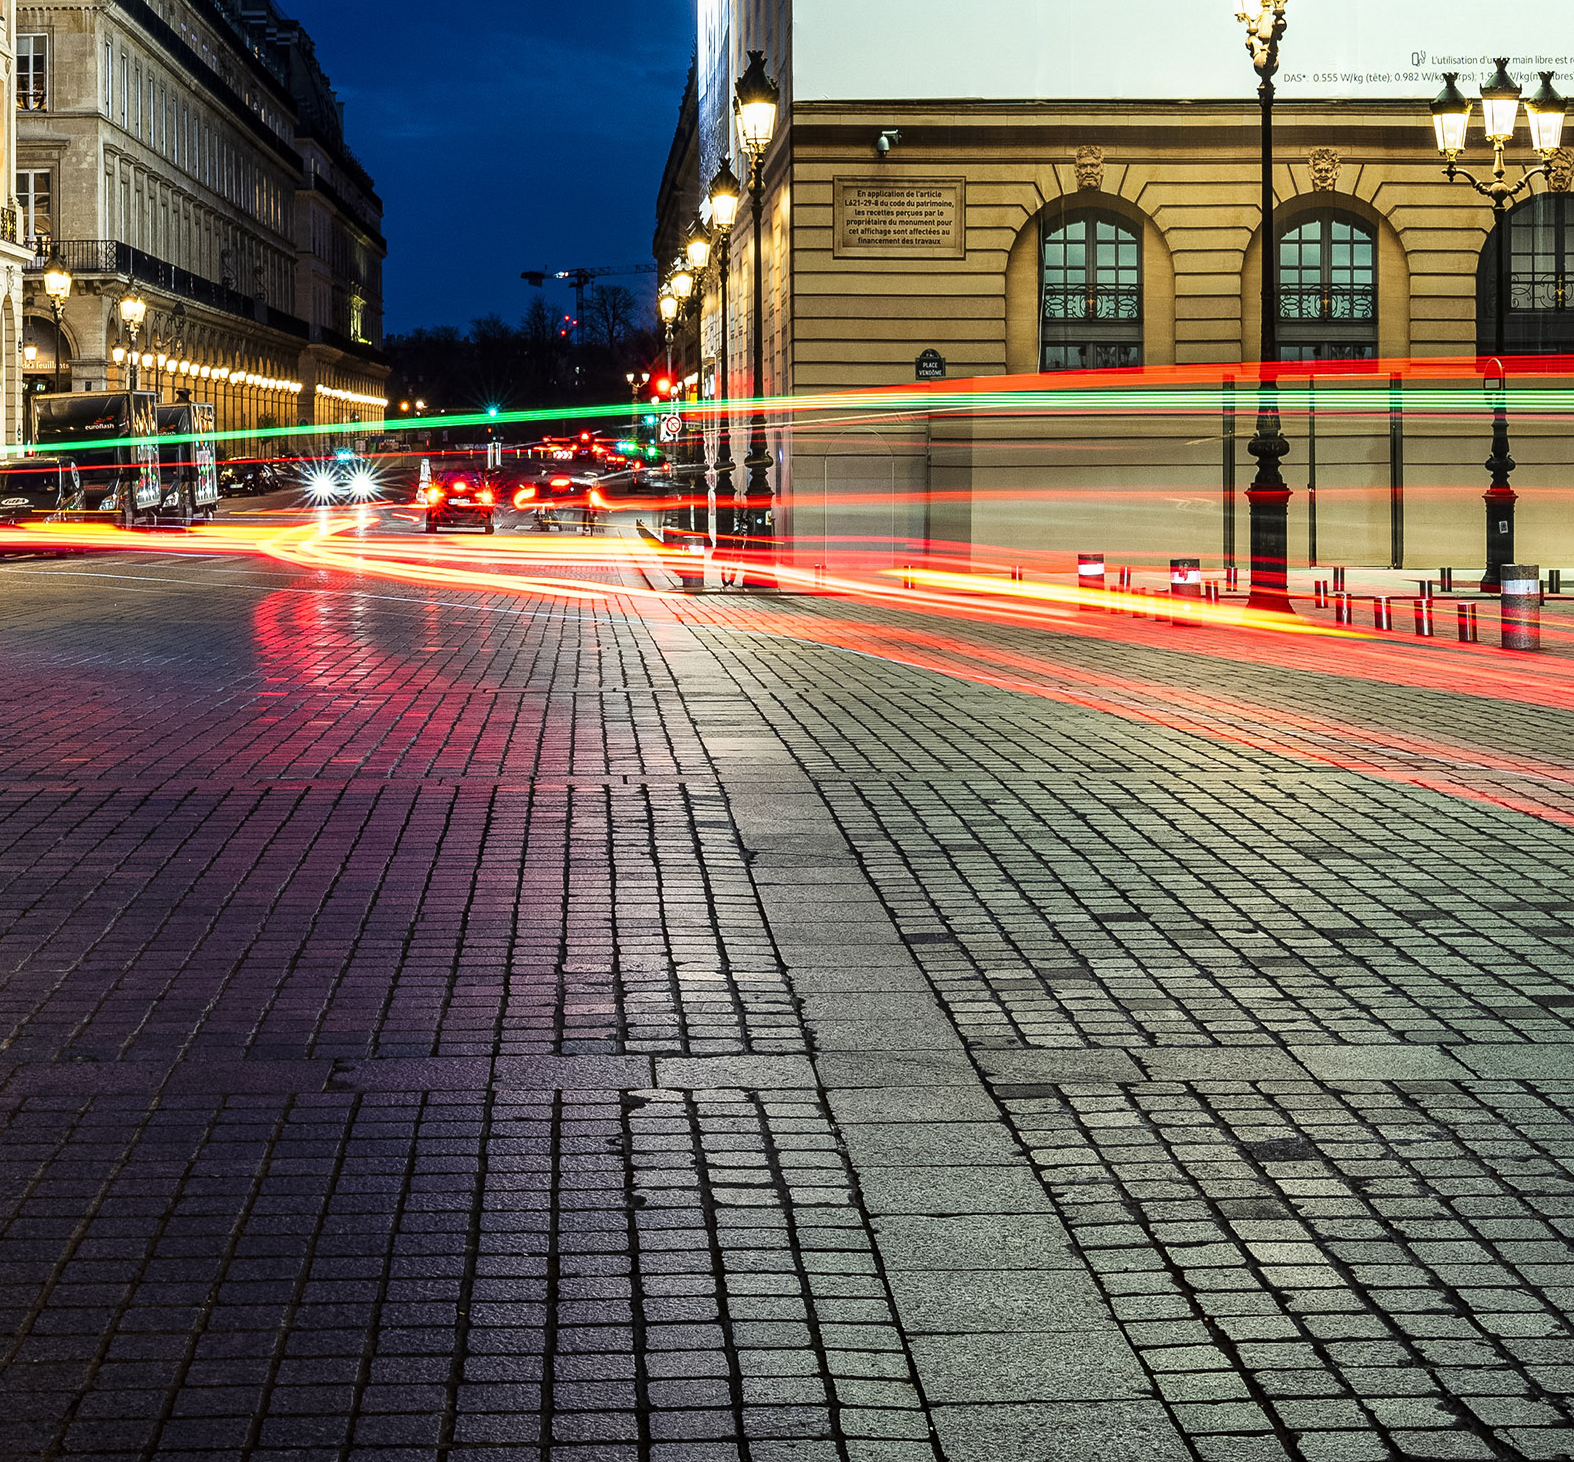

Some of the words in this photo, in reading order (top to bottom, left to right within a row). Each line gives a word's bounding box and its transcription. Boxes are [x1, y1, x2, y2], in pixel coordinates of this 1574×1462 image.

[1431, 55, 1478, 66] L'utilisation
[1512, 55, 1534, 65] main
[1534, 54, 1554, 65] libre
[1554, 55, 1569, 65] est
[1312, 73, 1339, 83] 0.555
[1340, 72, 1364, 85] W/kg
[1393, 71, 1420, 82] 0.982
[916, 200, 954, 208] patrimoine,
[896, 210, 923, 218] perçues
[846, 218, 886, 226] propriétaire
[860, 228, 891, 236] affichage
